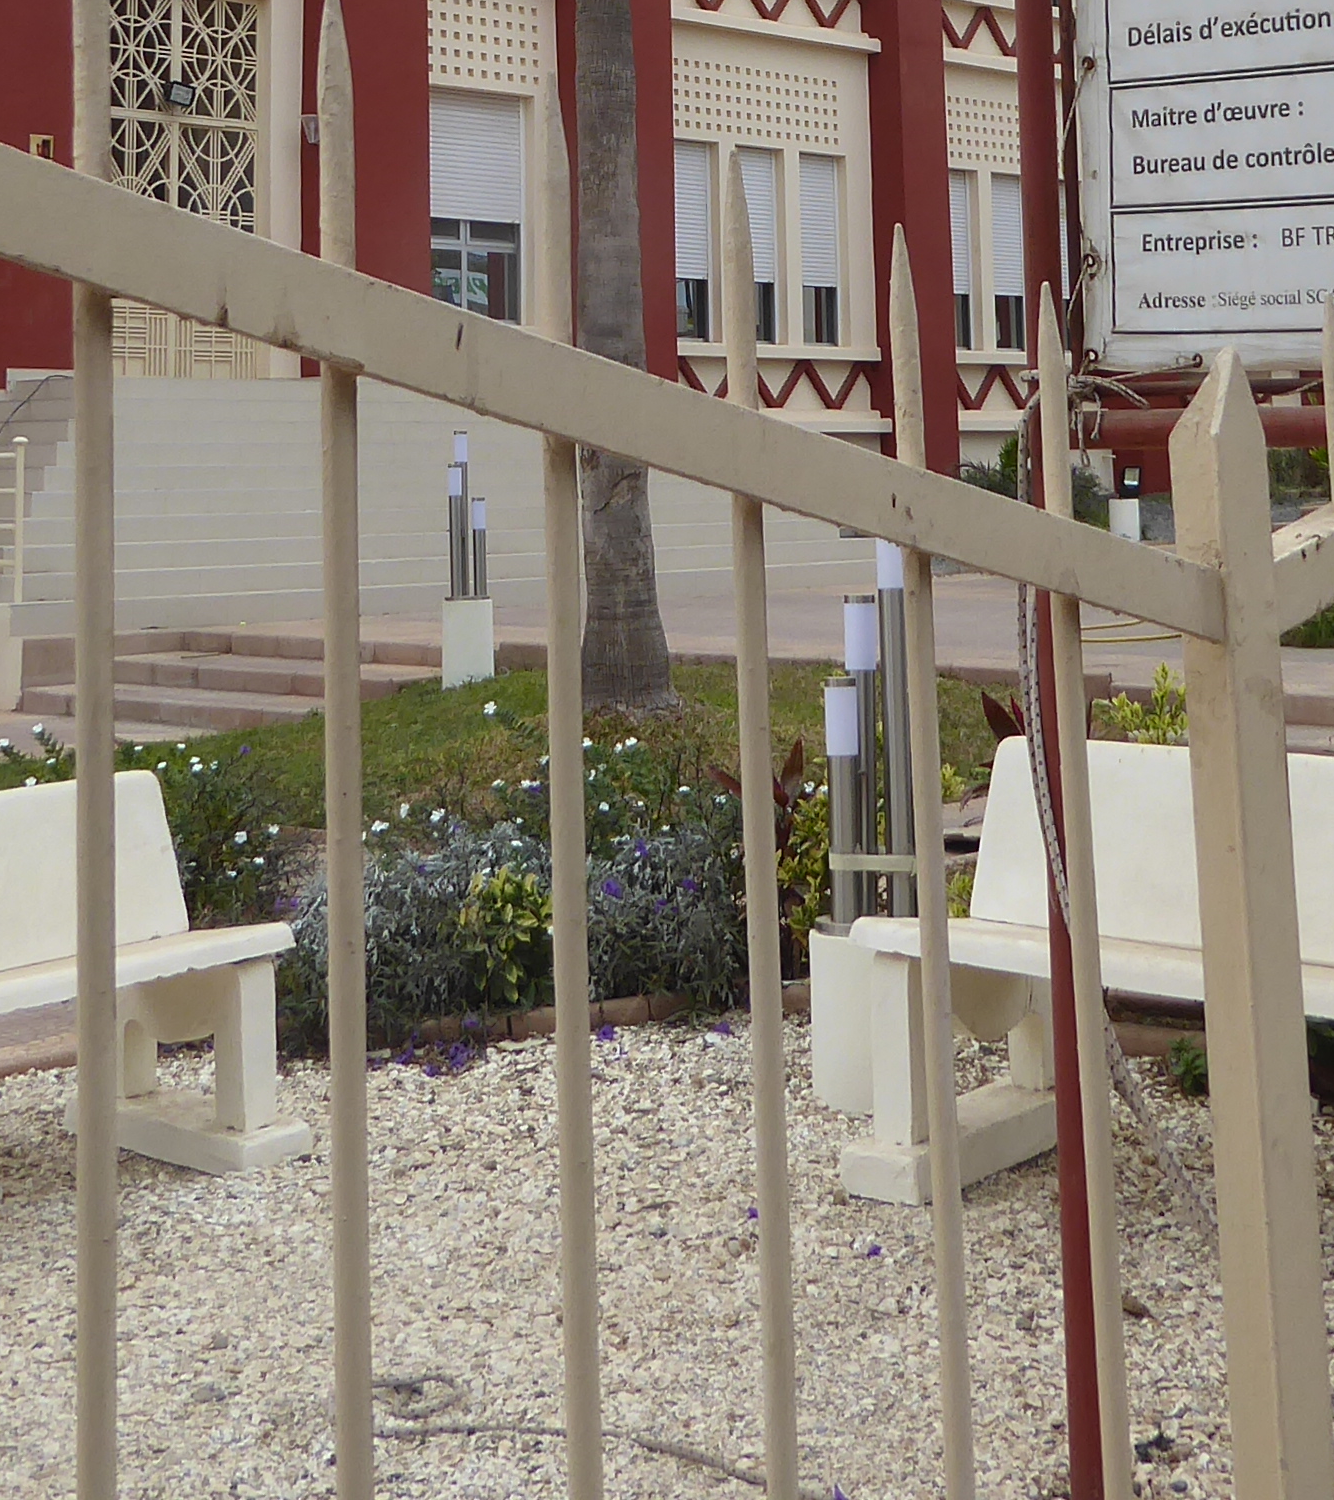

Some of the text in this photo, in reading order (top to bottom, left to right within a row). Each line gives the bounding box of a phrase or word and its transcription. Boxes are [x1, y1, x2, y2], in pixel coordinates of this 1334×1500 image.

[1127, 20, 1193, 48] Délais
[1198, 7, 1332, 41] d’exécution
[1203, 101, 1291, 124] d’œuvre
[1132, 155, 1206, 175] Bureau
[1212, 148, 1239, 171] de
[1142, 229, 1246, 256] Entreprise
[1281, 226, 1306, 248] BF
[1138, 291, 1207, 310] Adresse
[1260, 288, 1302, 306] social
